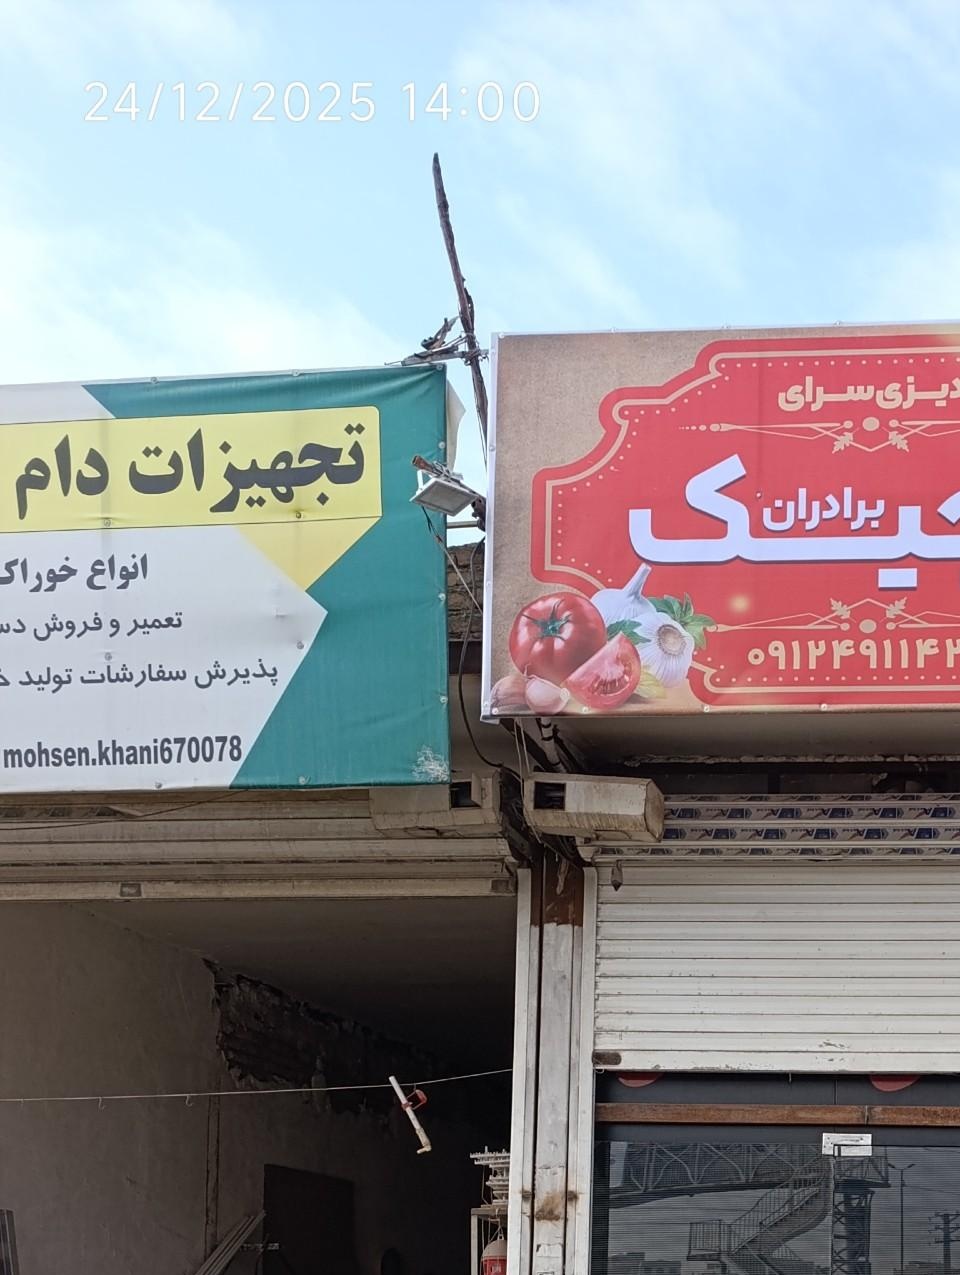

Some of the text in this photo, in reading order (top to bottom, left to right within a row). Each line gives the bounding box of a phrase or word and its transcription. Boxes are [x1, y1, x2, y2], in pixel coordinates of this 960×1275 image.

[15, 423, 365, 520] تجهیزات دام
[762, 487, 885, 533] برادران
[86, 553, 148, 590] انواع
[33, 611, 103, 641] فروش
[109, 616, 121, 636] و
[127, 611, 183, 635] تعمیر
[18, 666, 73, 694] تولید
[80, 659, 187, 688] سفارشات
[194, 656, 279, 689] پذیرش
[3, 735, 243, 768] mohsen.khani670078
